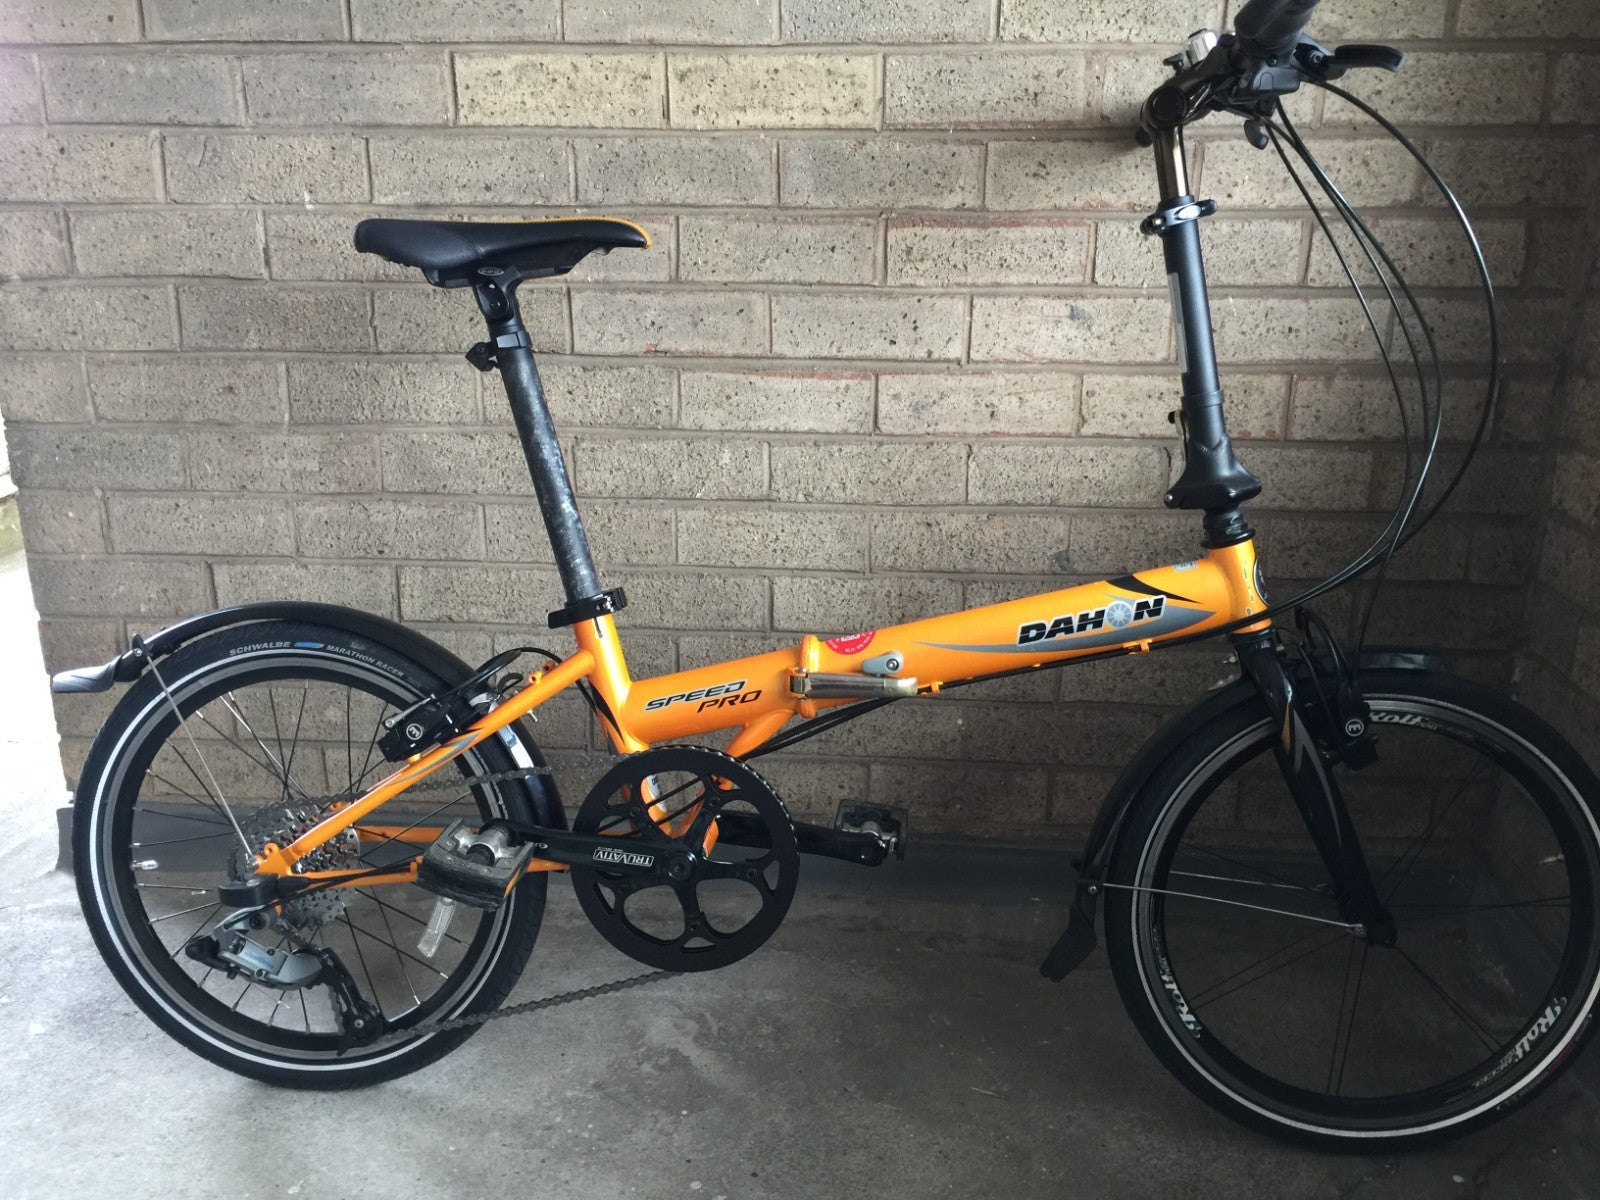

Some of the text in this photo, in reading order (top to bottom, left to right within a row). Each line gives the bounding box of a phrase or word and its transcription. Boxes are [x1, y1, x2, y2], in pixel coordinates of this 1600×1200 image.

[1017, 596, 1166, 646] DAHON
[229, 641, 291, 656] SCHWALBE
[326, 644, 375, 664] MARATHON
[375, 660, 404, 678] RACER
[644, 680, 746, 712] SPEED
[696, 689, 762, 713] PRO
[595, 850, 651, 866] TRUVATIV
